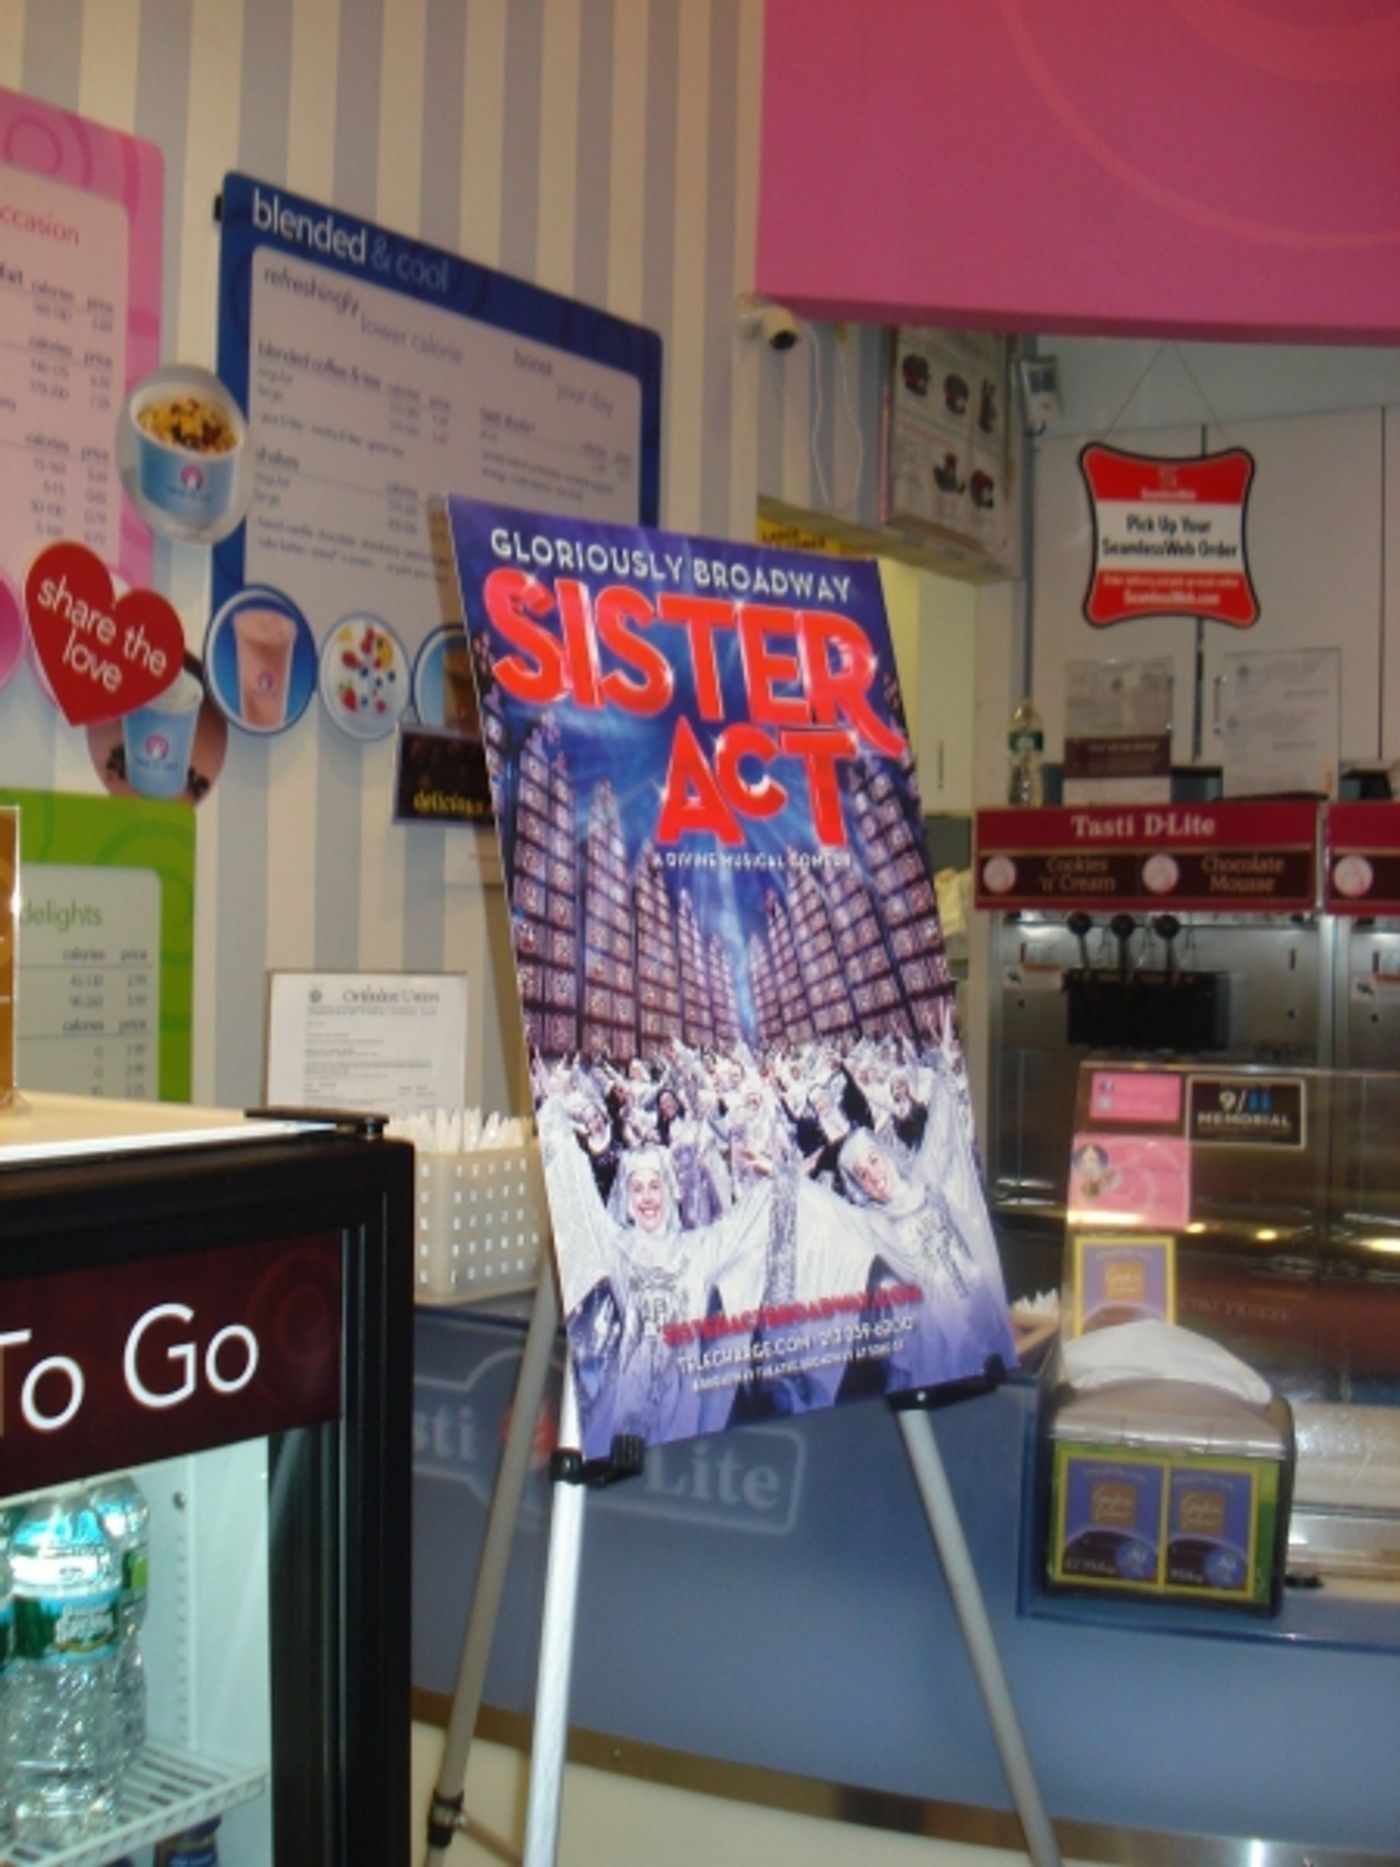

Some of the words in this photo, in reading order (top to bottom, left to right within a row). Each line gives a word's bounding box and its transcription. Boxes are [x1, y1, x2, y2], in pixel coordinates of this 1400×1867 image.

[253, 186, 367, 265] blended
[371, 235, 393, 273] &
[395, 252, 449, 293] cool
[1126, 513, 1154, 533] Pick
[1158, 515, 1177, 535] Up
[1182, 515, 1211, 533] Your
[490, 528, 684, 580] GLORIOUSLY
[693, 562, 852, 604] BROADWAY
[37, 574, 117, 646] share
[123, 624, 167, 677] the
[62, 628, 122, 695] love
[483, 566, 907, 758] SISTER
[655, 715, 859, 848] ACT
[1071, 814, 1134, 838] Tasti
[19, 900, 104, 931] delights
[1197, 1112, 1291, 1129] MEMORIAL
[1219, 1088, 1273, 1114] 9/11
[0, 1327, 85, 1432] To
[123, 1302, 259, 1409] Go
[646, 1445, 779, 1511] Lite
